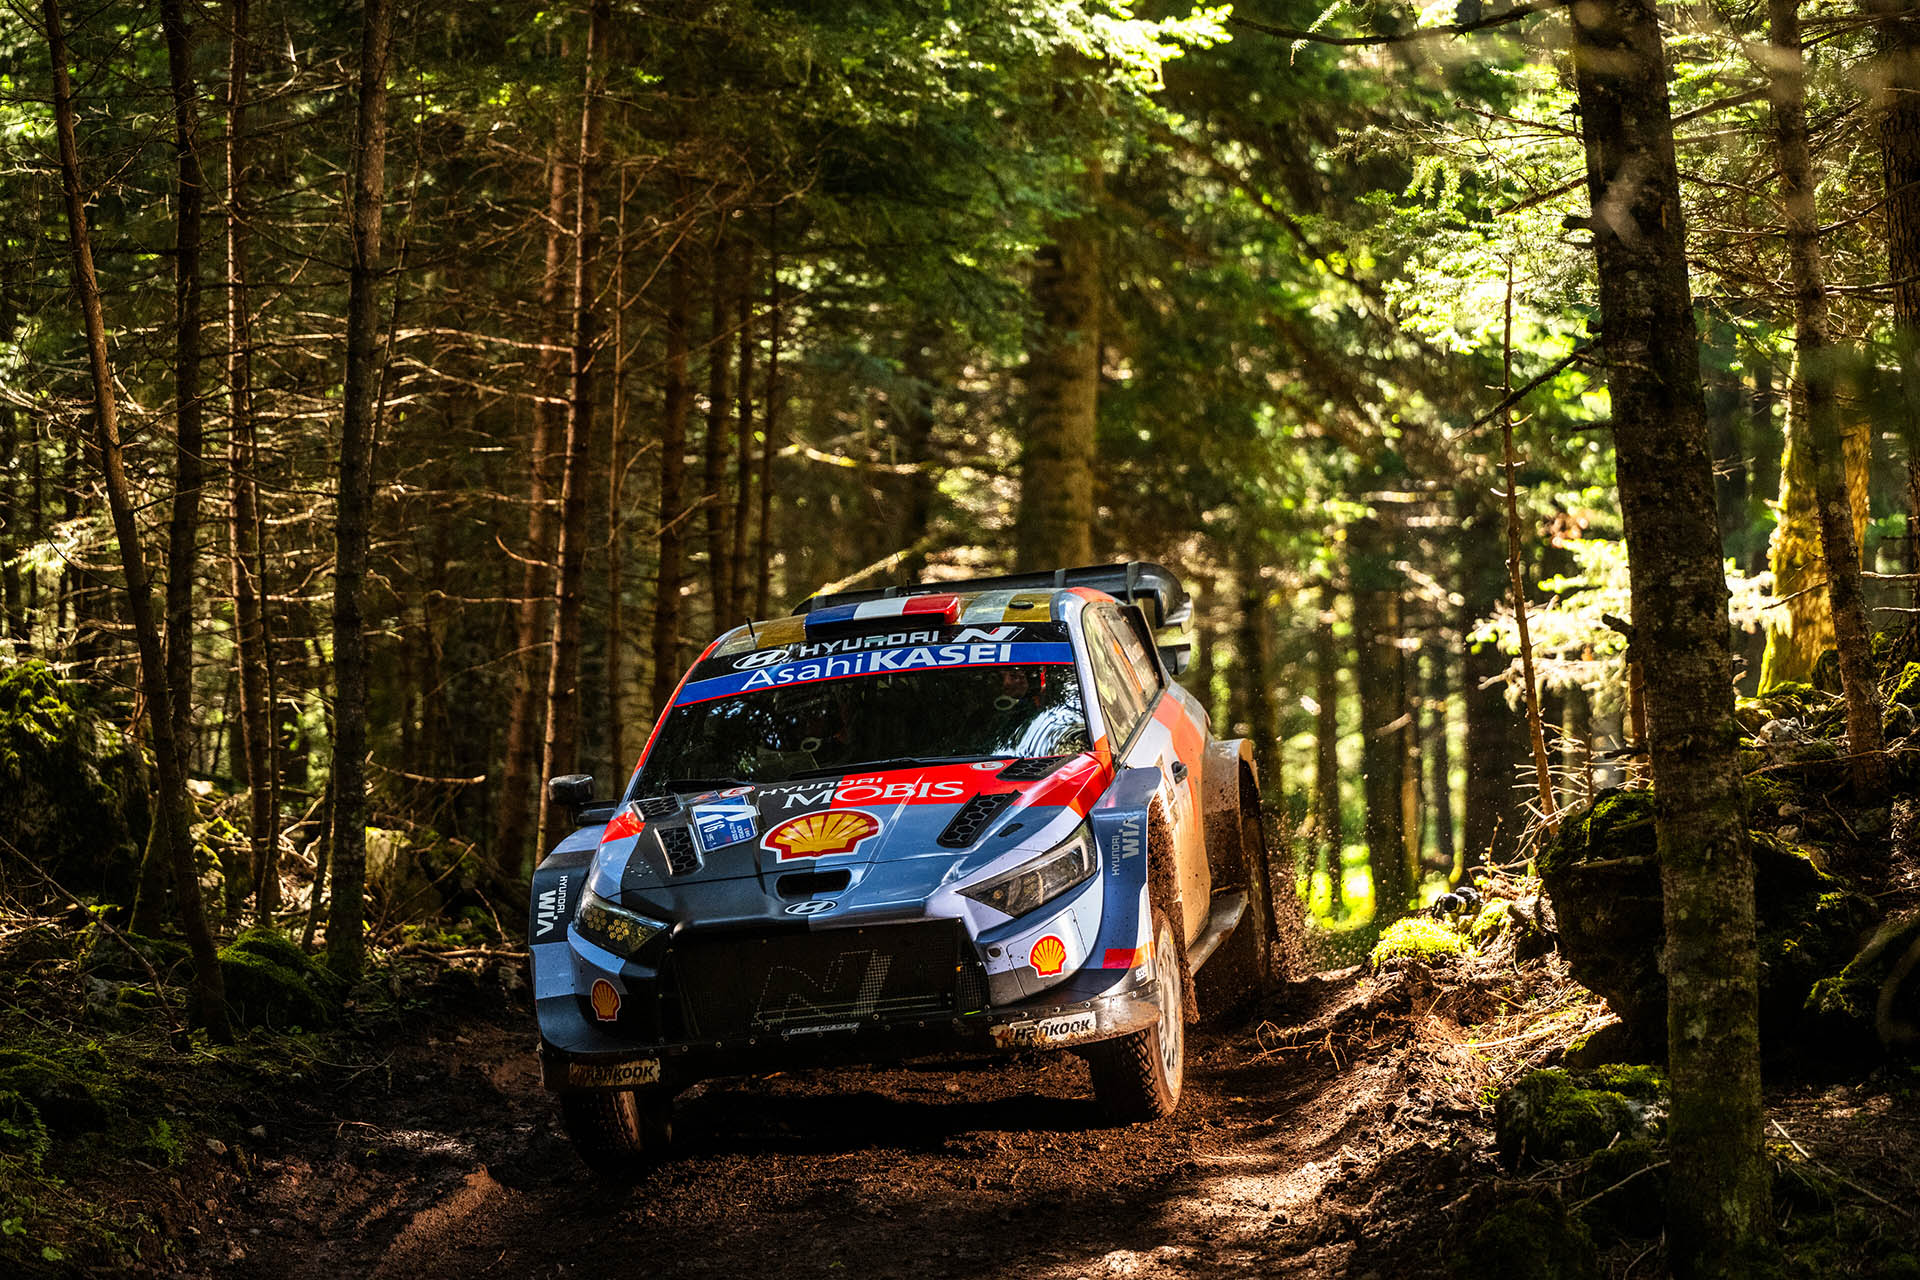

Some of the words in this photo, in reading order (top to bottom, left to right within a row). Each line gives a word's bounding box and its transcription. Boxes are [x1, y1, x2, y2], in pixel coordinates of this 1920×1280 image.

[800, 631, 939, 657] HYUNDAI
[740, 643, 1012, 690] AsahiKASEI
[758, 777, 883, 798] HYUNDAI
[781, 781, 964, 809] MOBIS
[1111, 835, 1120, 876] HYUNDAI
[557, 875, 569, 914] HYUNDAI
